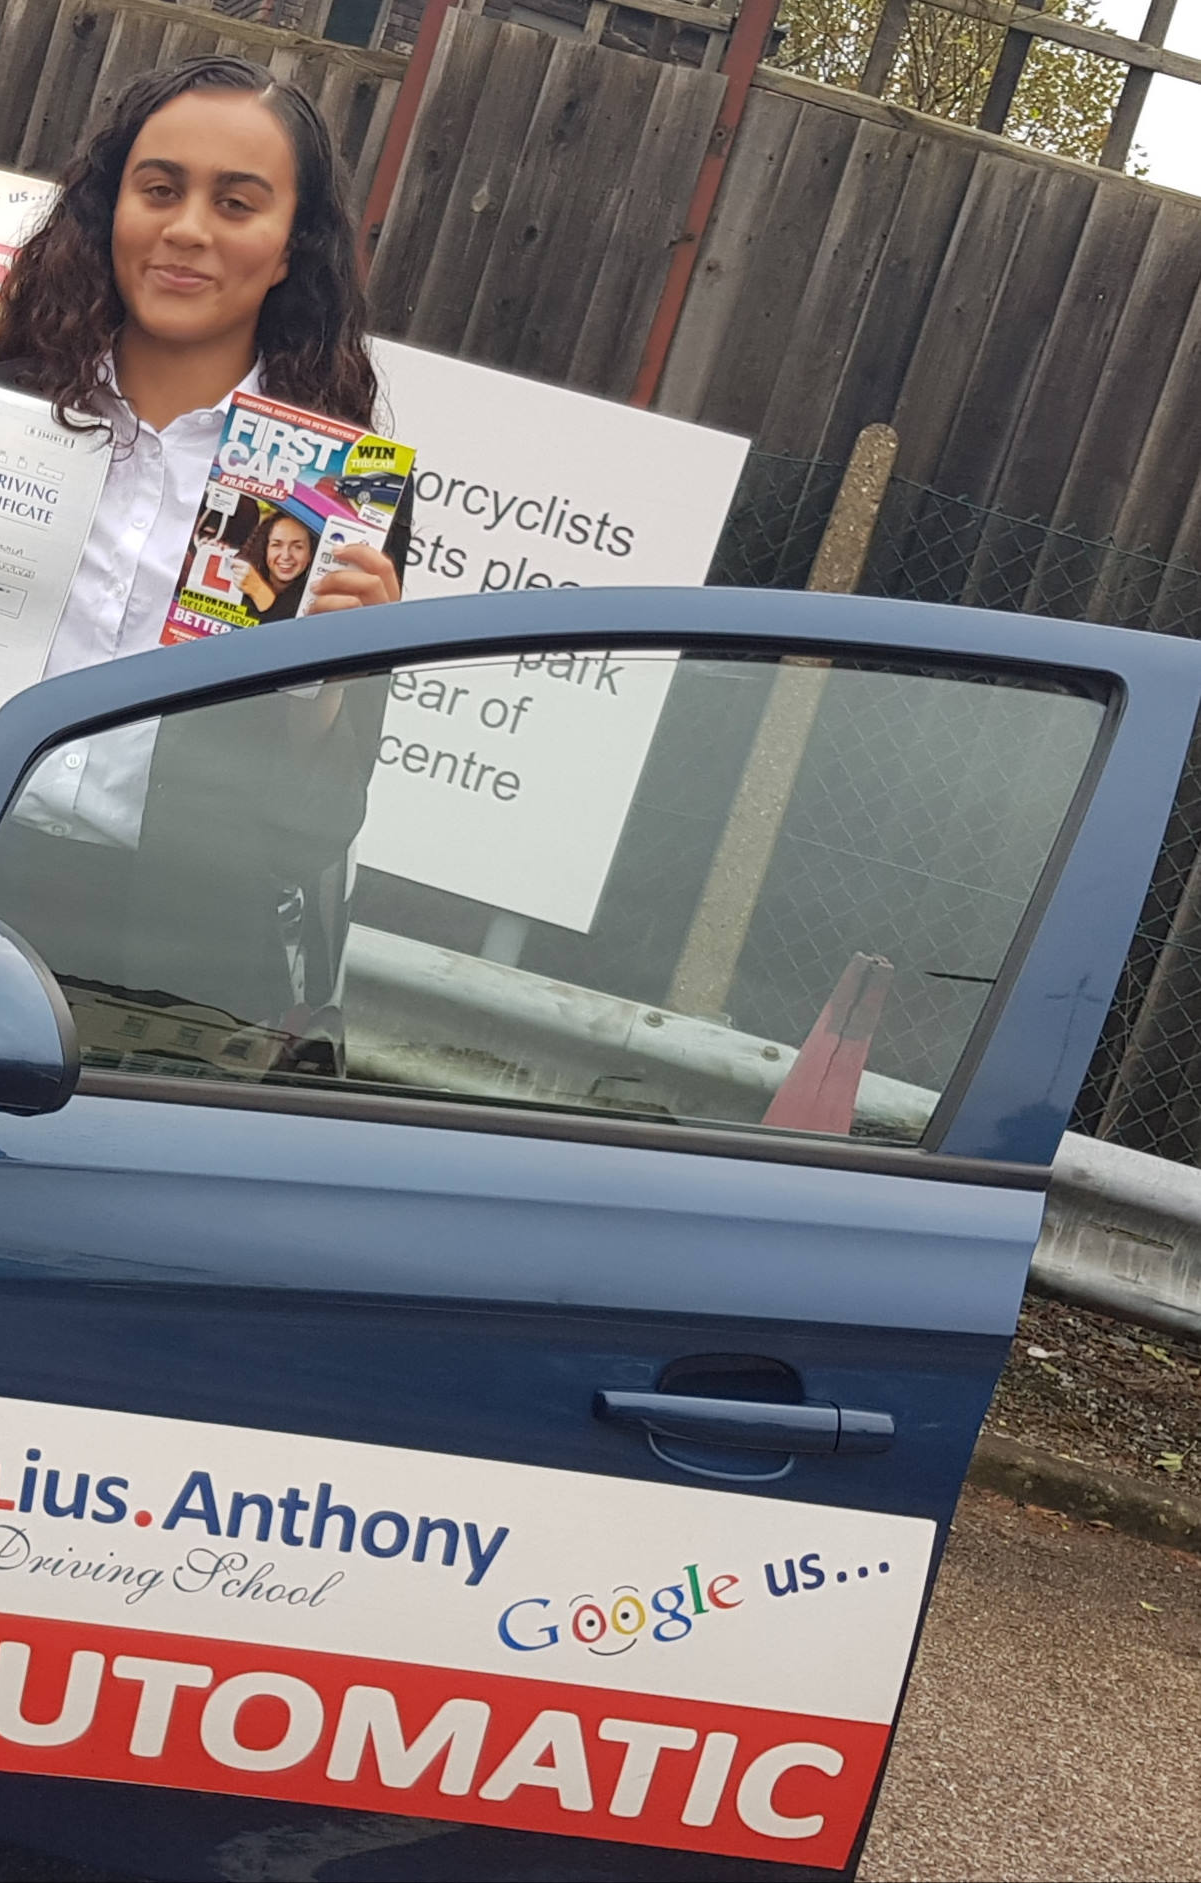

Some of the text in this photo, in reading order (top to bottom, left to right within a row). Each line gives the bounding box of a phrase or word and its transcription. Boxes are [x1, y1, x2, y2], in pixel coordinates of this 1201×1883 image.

[227, 407, 345, 472] FIRST
[357, 445, 397, 461] WIN
[218, 441, 301, 496] CAR
[219, 473, 287, 501] PRACTICAL
[411, 466, 635, 557] orcyclists
[201, 554, 231, 593] L
[182, 589, 205, 605] PASS
[207, 604, 230, 622] MAKE
[513, 650, 626, 696] park
[480, 696, 534, 734] of
[376, 735, 521, 801] centre
[173, 1547, 346, 1608] School
[497, 1552, 891, 1652] Google us...
